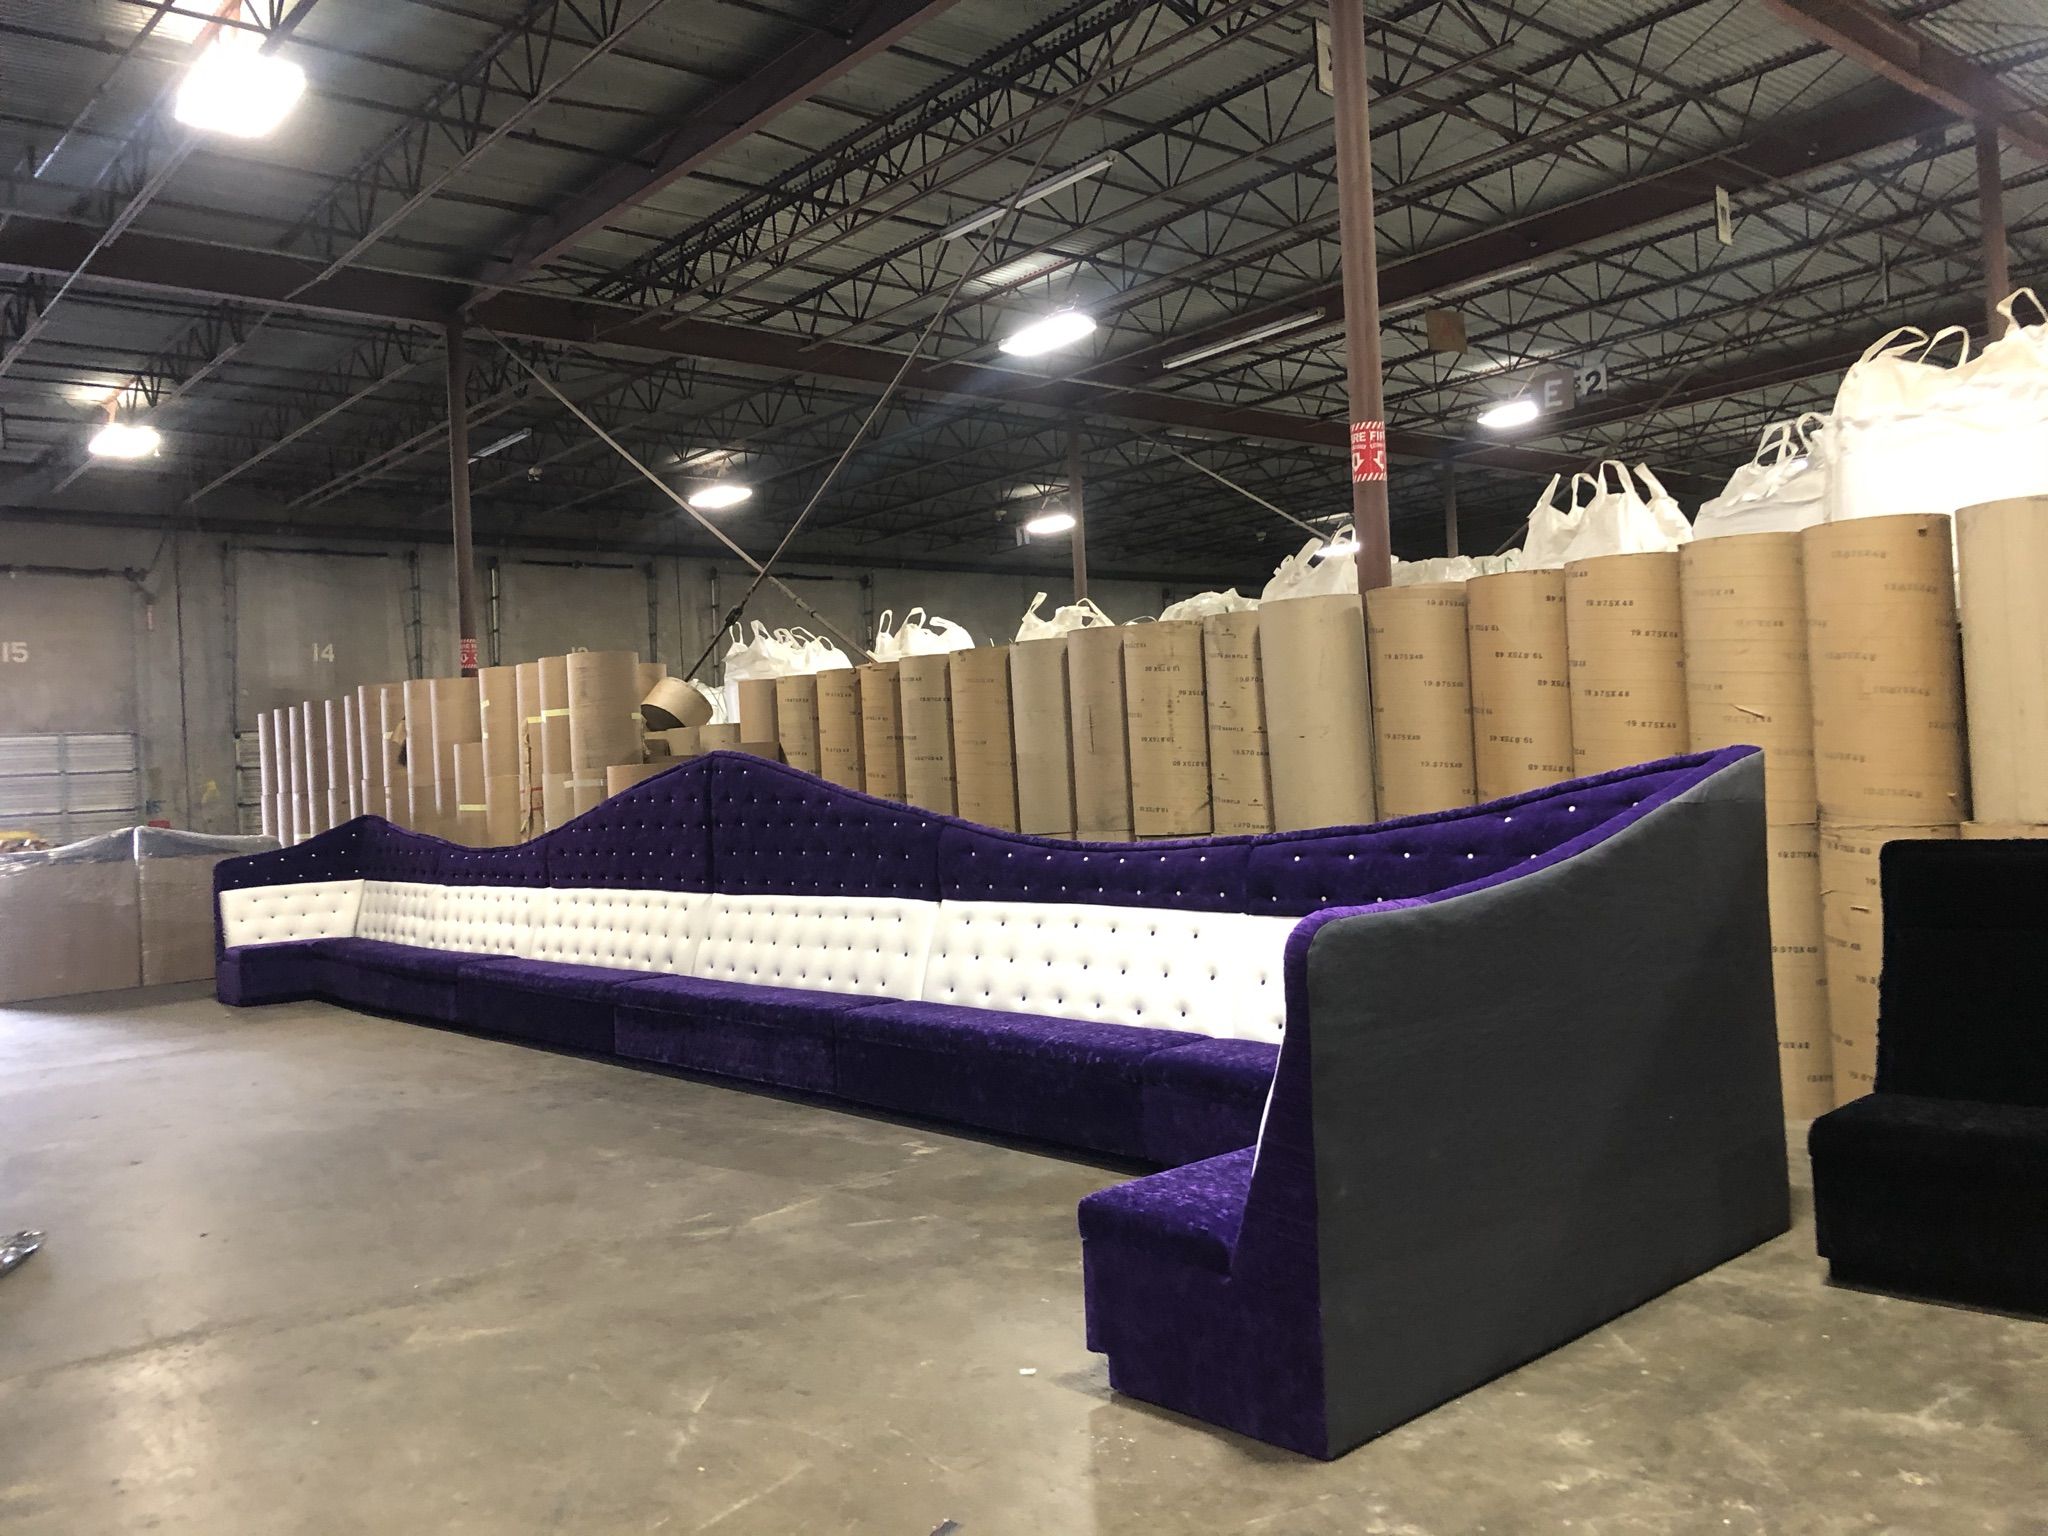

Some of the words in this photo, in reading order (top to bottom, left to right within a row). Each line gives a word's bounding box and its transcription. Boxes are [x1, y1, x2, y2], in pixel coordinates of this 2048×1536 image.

[1544, 379, 1563, 409] E
[2, 641, 28, 663] 15
[312, 643, 335, 662] 14
